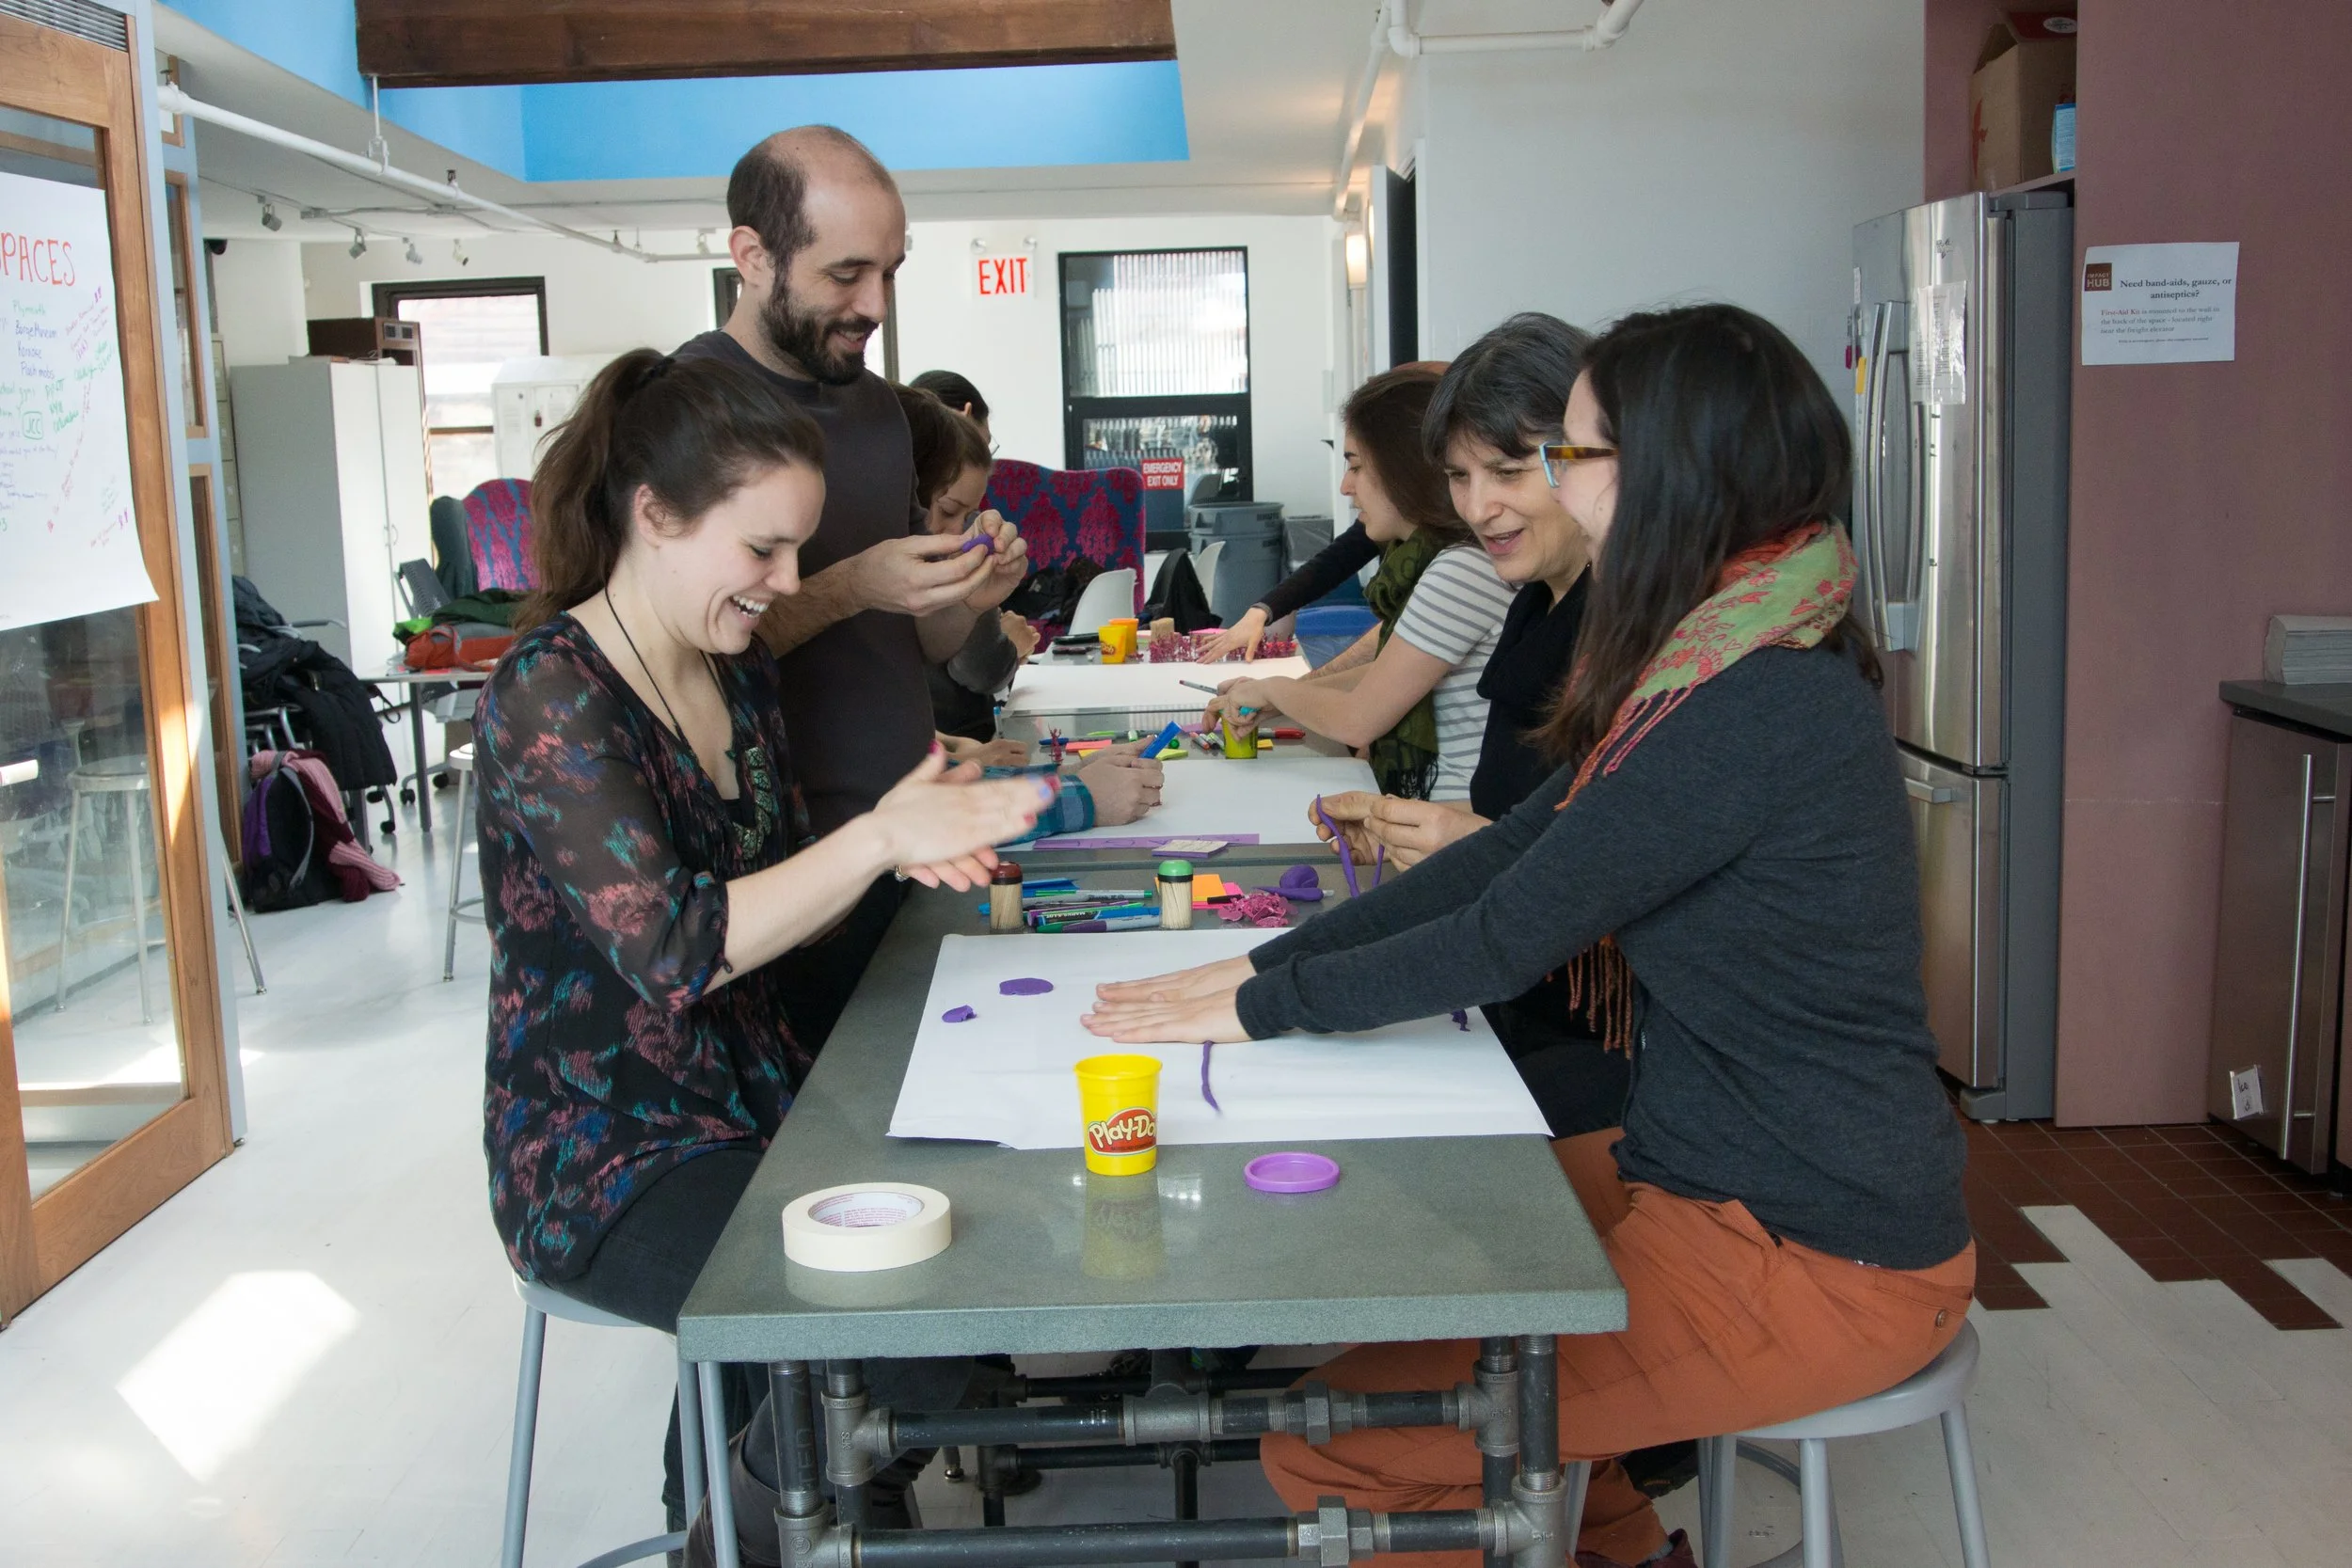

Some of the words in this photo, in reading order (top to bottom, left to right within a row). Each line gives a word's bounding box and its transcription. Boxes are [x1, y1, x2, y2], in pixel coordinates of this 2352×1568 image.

[0, 232, 75, 287] PACES
[977, 257, 1028, 295] EXIT
[2087, 277, 2110, 288] HUB
[2120, 279, 2143, 288] Need
[2145, 278, 2190, 288] band-aids,
[2191, 279, 2220, 289] gauze,
[2150, 290, 2201, 301] antiseptics?
[1143, 462, 1183, 474] EMERGENCY
[1147, 475, 1162, 486] EXIT
[1162, 474, 1179, 486] ONLY
[1089, 1115, 1155, 1148] Play-Do
